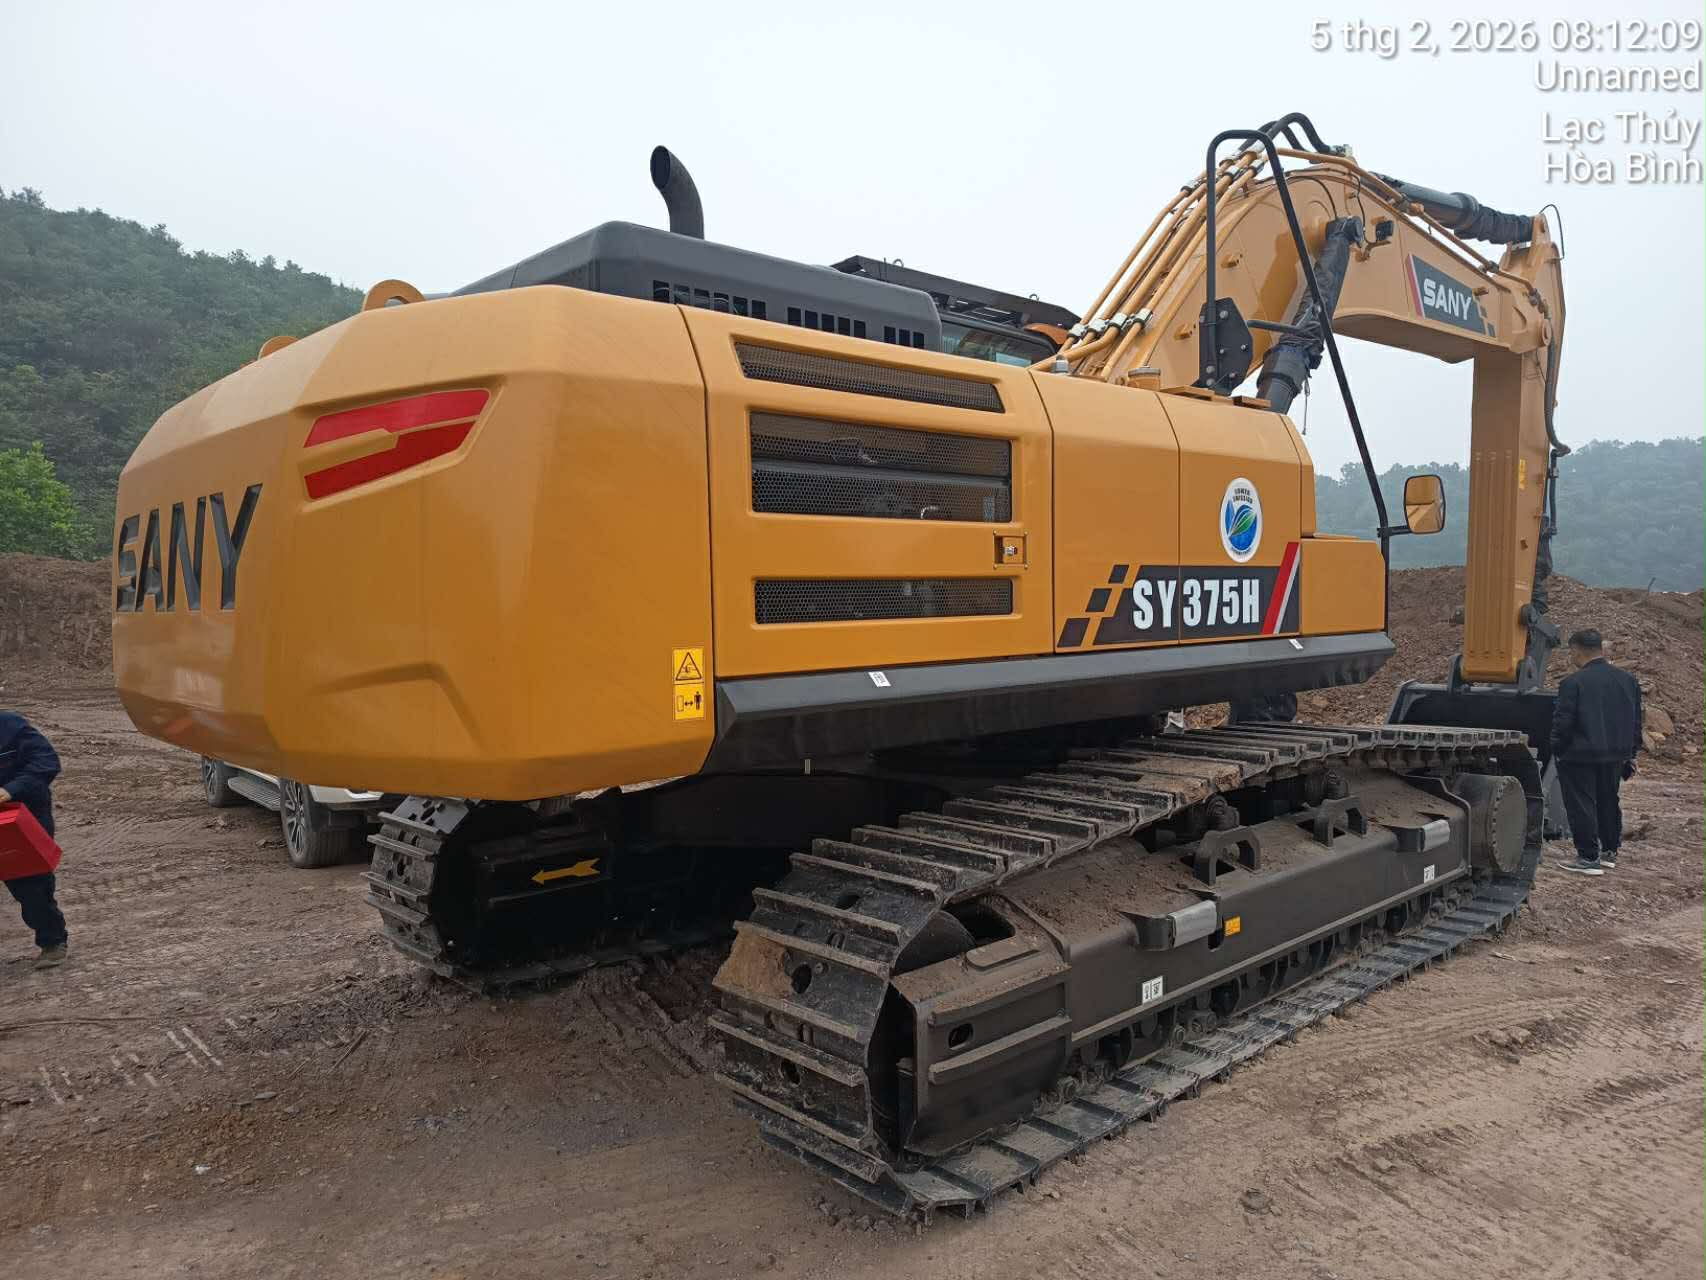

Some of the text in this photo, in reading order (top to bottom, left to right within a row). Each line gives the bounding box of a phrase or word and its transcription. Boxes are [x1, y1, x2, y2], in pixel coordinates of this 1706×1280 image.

[1423, 278, 1472, 321] SANY
[116, 483, 263, 612] SANY
[1132, 578, 1260, 630] SY375H
